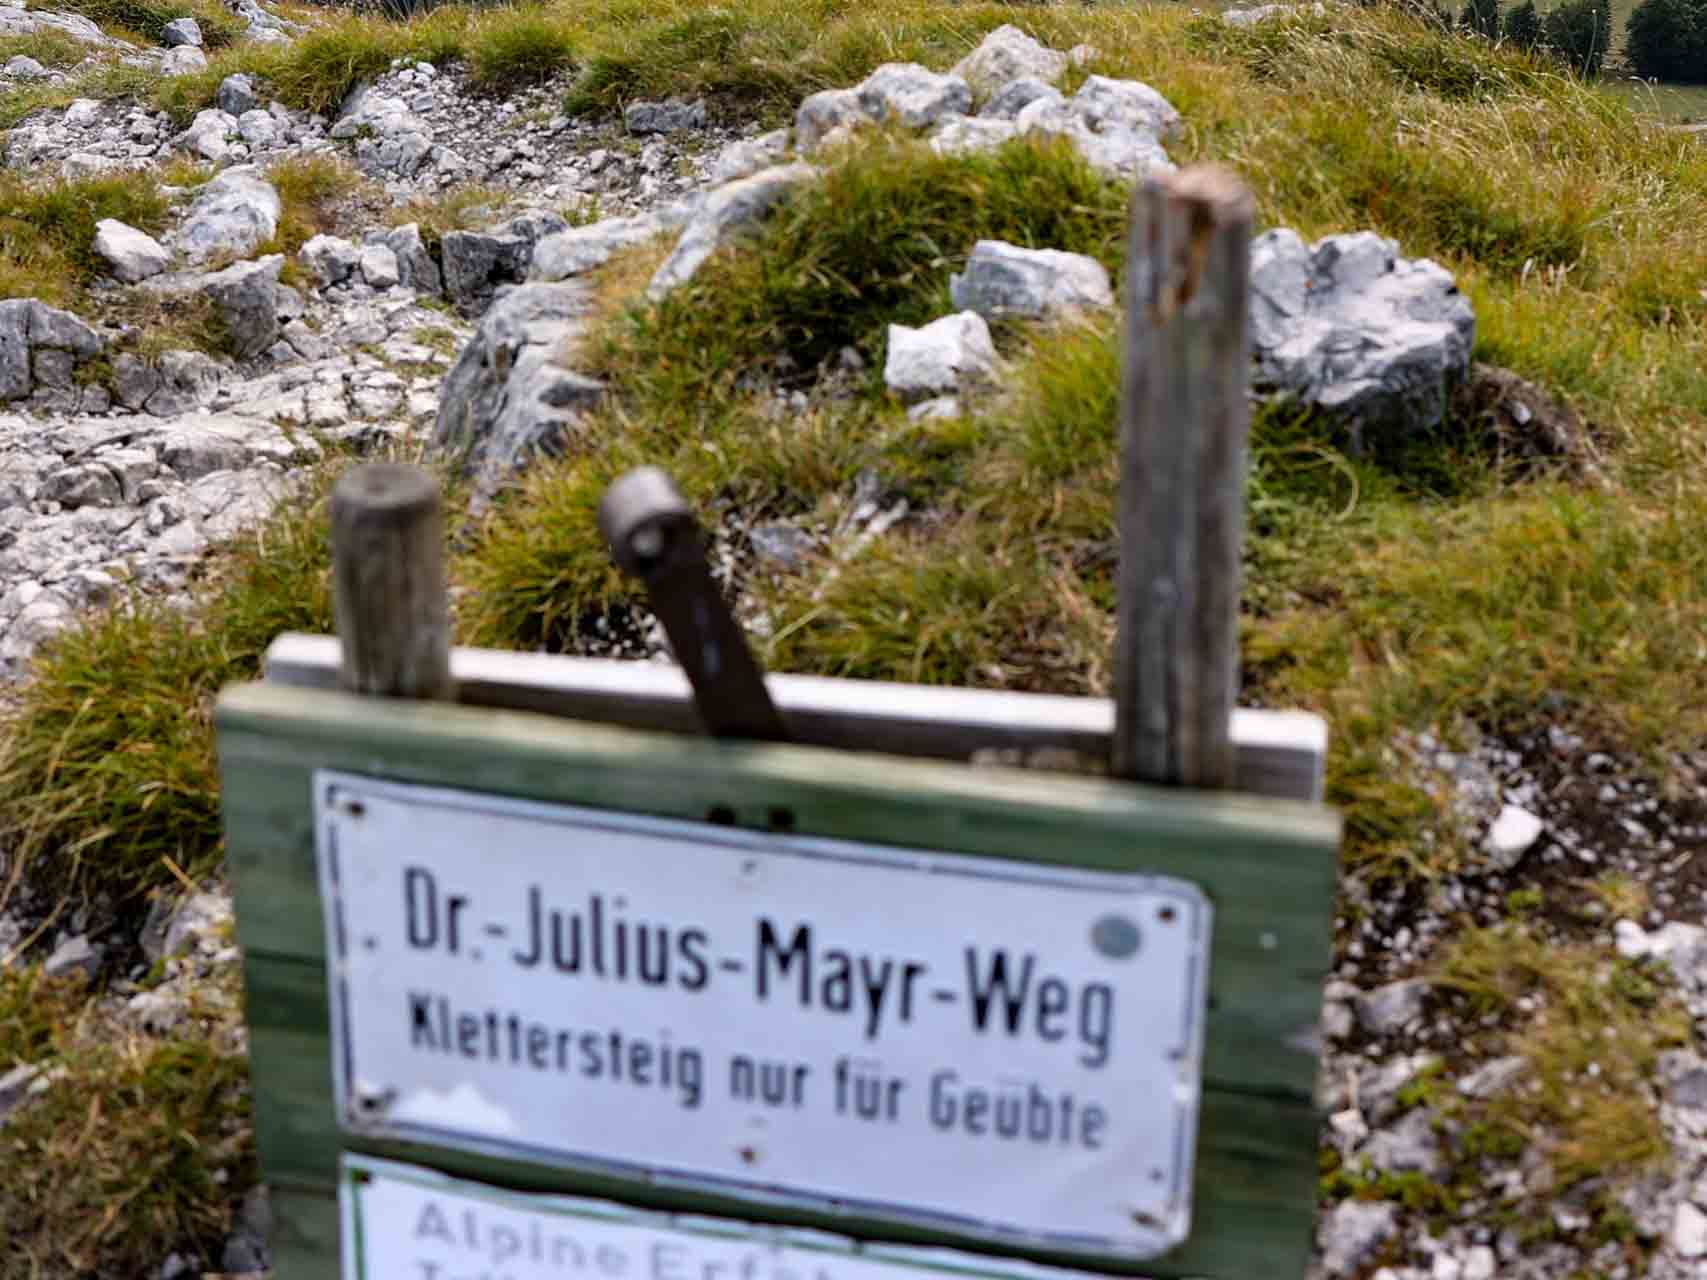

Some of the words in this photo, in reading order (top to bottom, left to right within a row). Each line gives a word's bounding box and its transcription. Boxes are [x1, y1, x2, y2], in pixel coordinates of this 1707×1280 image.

[404, 867, 1114, 1068] Dr.-Julius-Mayr-Weg
[408, 991, 702, 1109] Klettersteig
[730, 1054, 808, 1106] nur
[834, 1058, 903, 1123] für
[929, 1070, 1107, 1149] Geübte
[415, 1202, 632, 1276] Alpine
